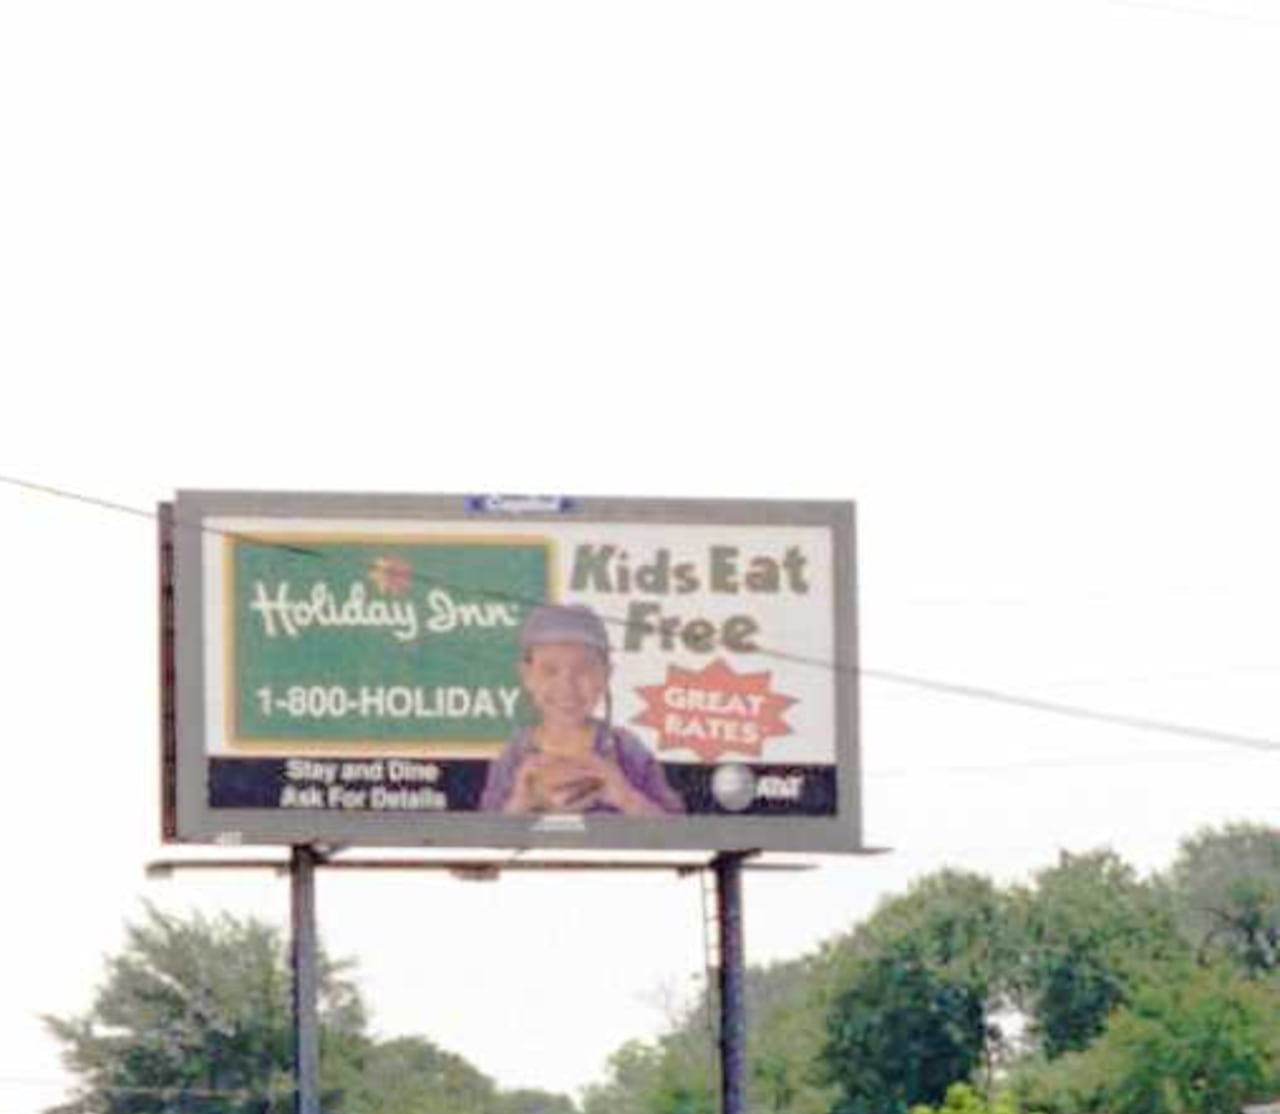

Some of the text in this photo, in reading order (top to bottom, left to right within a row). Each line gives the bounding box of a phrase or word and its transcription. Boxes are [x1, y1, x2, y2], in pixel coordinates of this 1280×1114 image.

[570, 545, 808, 594] Kids Eat
[249, 580, 520, 642] Holiday Inn
[624, 602, 759, 652] Free
[256, 685, 520, 718] 1-800-HOLIDAY
[664, 686, 766, 718] GREAT
[663, 713, 762, 743] RATES
[284, 760, 440, 784] Stay and Dine
[279, 786, 447, 810] Ask For Details
